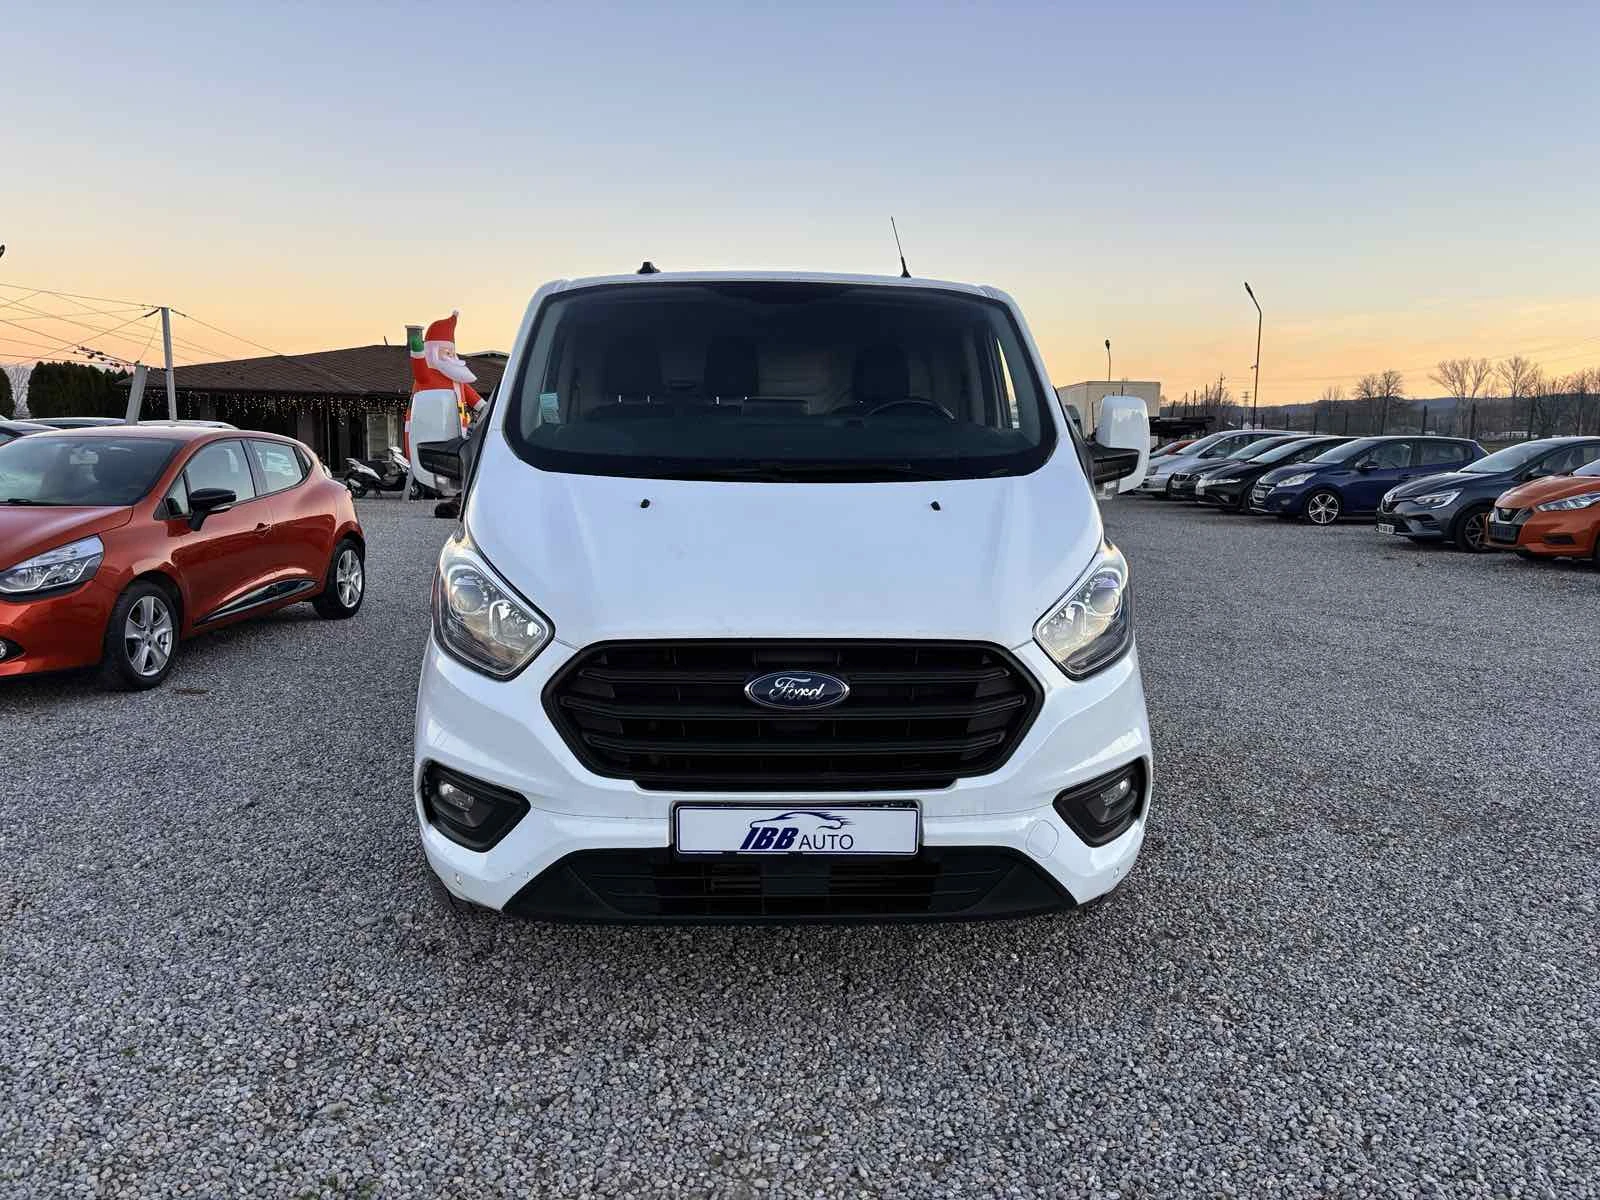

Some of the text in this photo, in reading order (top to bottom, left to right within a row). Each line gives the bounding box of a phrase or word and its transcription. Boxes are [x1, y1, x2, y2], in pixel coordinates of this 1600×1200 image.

[768, 676, 825, 700] Ford
[739, 826, 854, 850] IBB AUTO
